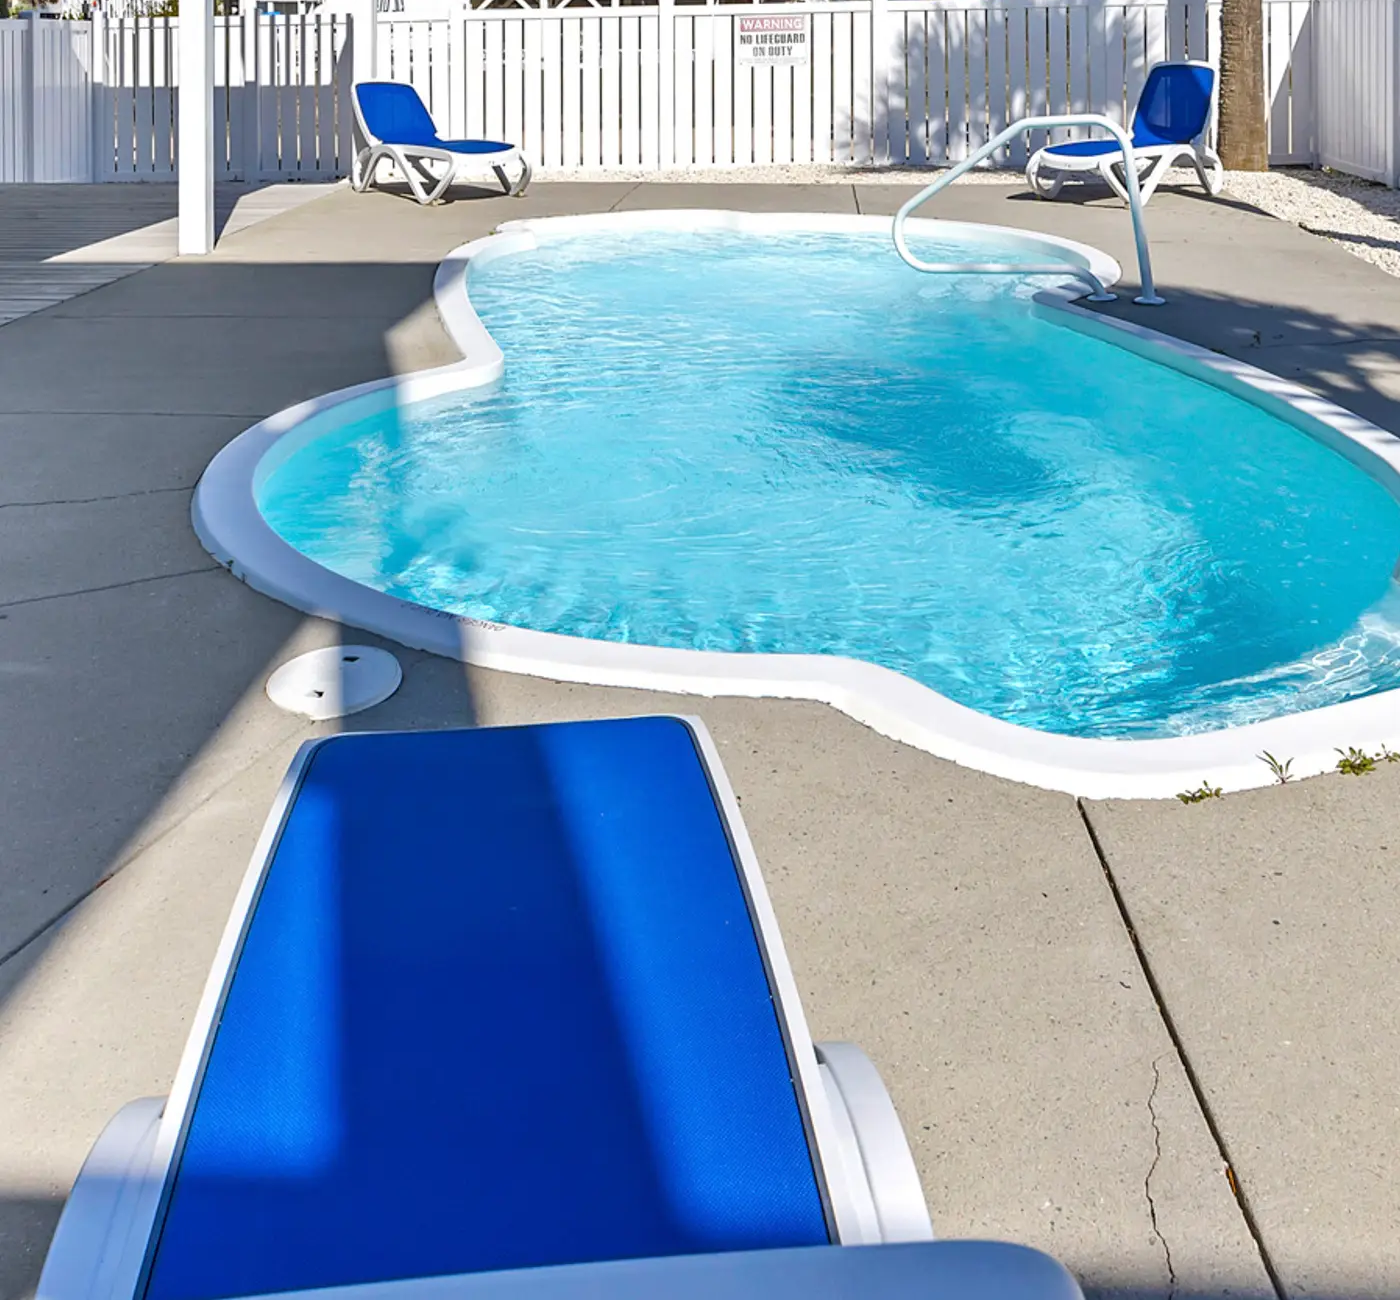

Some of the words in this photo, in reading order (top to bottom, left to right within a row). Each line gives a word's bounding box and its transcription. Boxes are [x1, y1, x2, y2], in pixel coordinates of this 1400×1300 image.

[743, 19, 802, 30] WARNING
[740, 34, 752, 44] NO
[756, 33, 805, 44] LIFEGUARD
[753, 46, 765, 57] ON
[768, 46, 793, 56] DUTY
